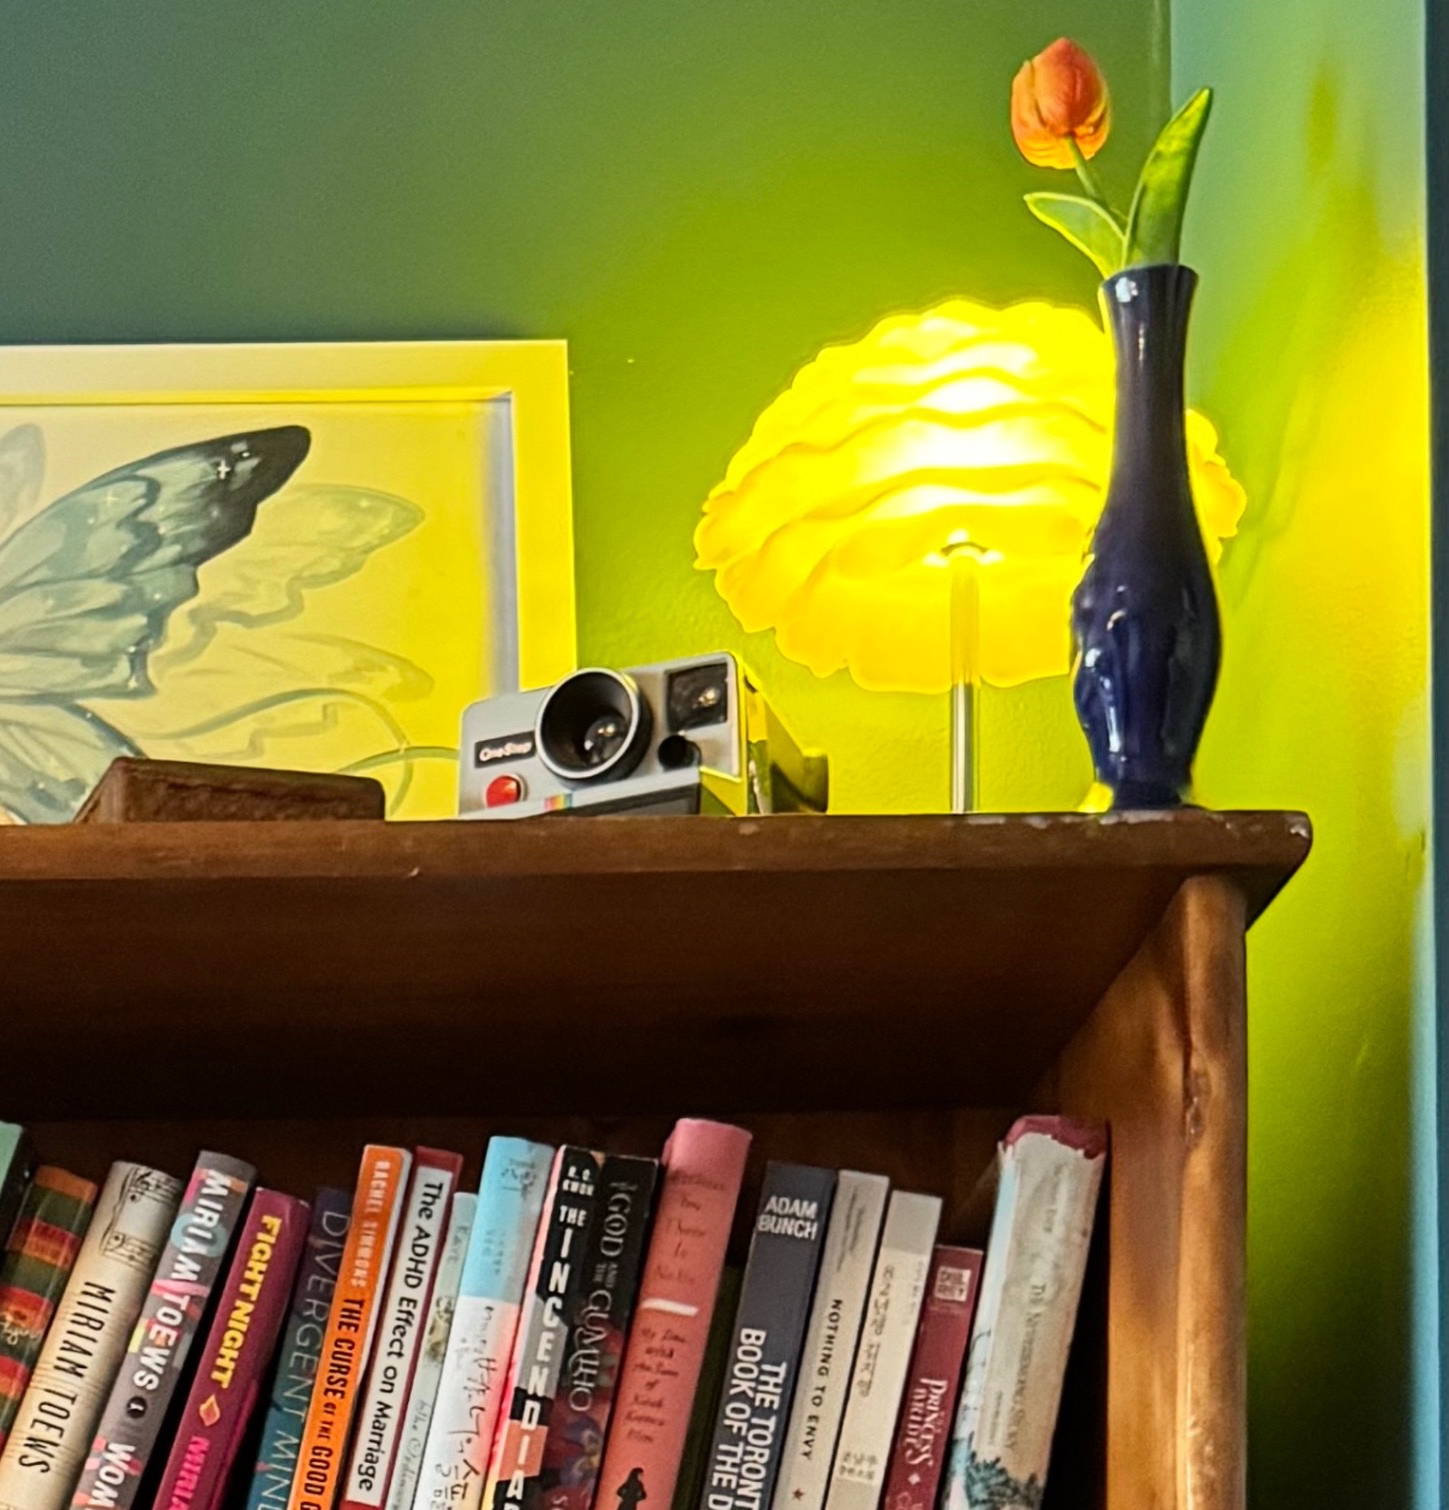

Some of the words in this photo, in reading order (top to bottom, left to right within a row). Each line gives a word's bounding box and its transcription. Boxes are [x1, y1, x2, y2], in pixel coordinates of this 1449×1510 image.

[478, 740, 532, 762] OneStep
[169, 1169, 233, 1284] MIRIAM
[416, 1179, 442, 1222] The
[764, 1194, 818, 1220] ADAM
[757, 1214, 819, 1242] BUNCH
[401, 1225, 431, 1290] ADHD
[51, 1279, 116, 1380] MIRIAM
[129, 1287, 189, 1393] TOEWS
[277, 1209, 351, 1422] DIVERGENT
[337, 1296, 364, 1333] THE
[384, 1295, 416, 1362] Effect
[815, 1298, 844, 1379] NOTHING
[323, 1337, 356, 1399] CURSE
[378, 1366, 397, 1393] on
[729, 1326, 765, 1397] BOOK
[753, 1358, 786, 1410] THE
[722, 1401, 751, 1434] OF
[809, 1385, 826, 1408] TO
[15, 1382, 77, 1476] TOEWS
[353, 1398, 394, 1493] Marriage
[798, 1413, 821, 1461] ENVY
[302, 1444, 333, 1497] GOOD
[710, 1441, 743, 1490] THE
